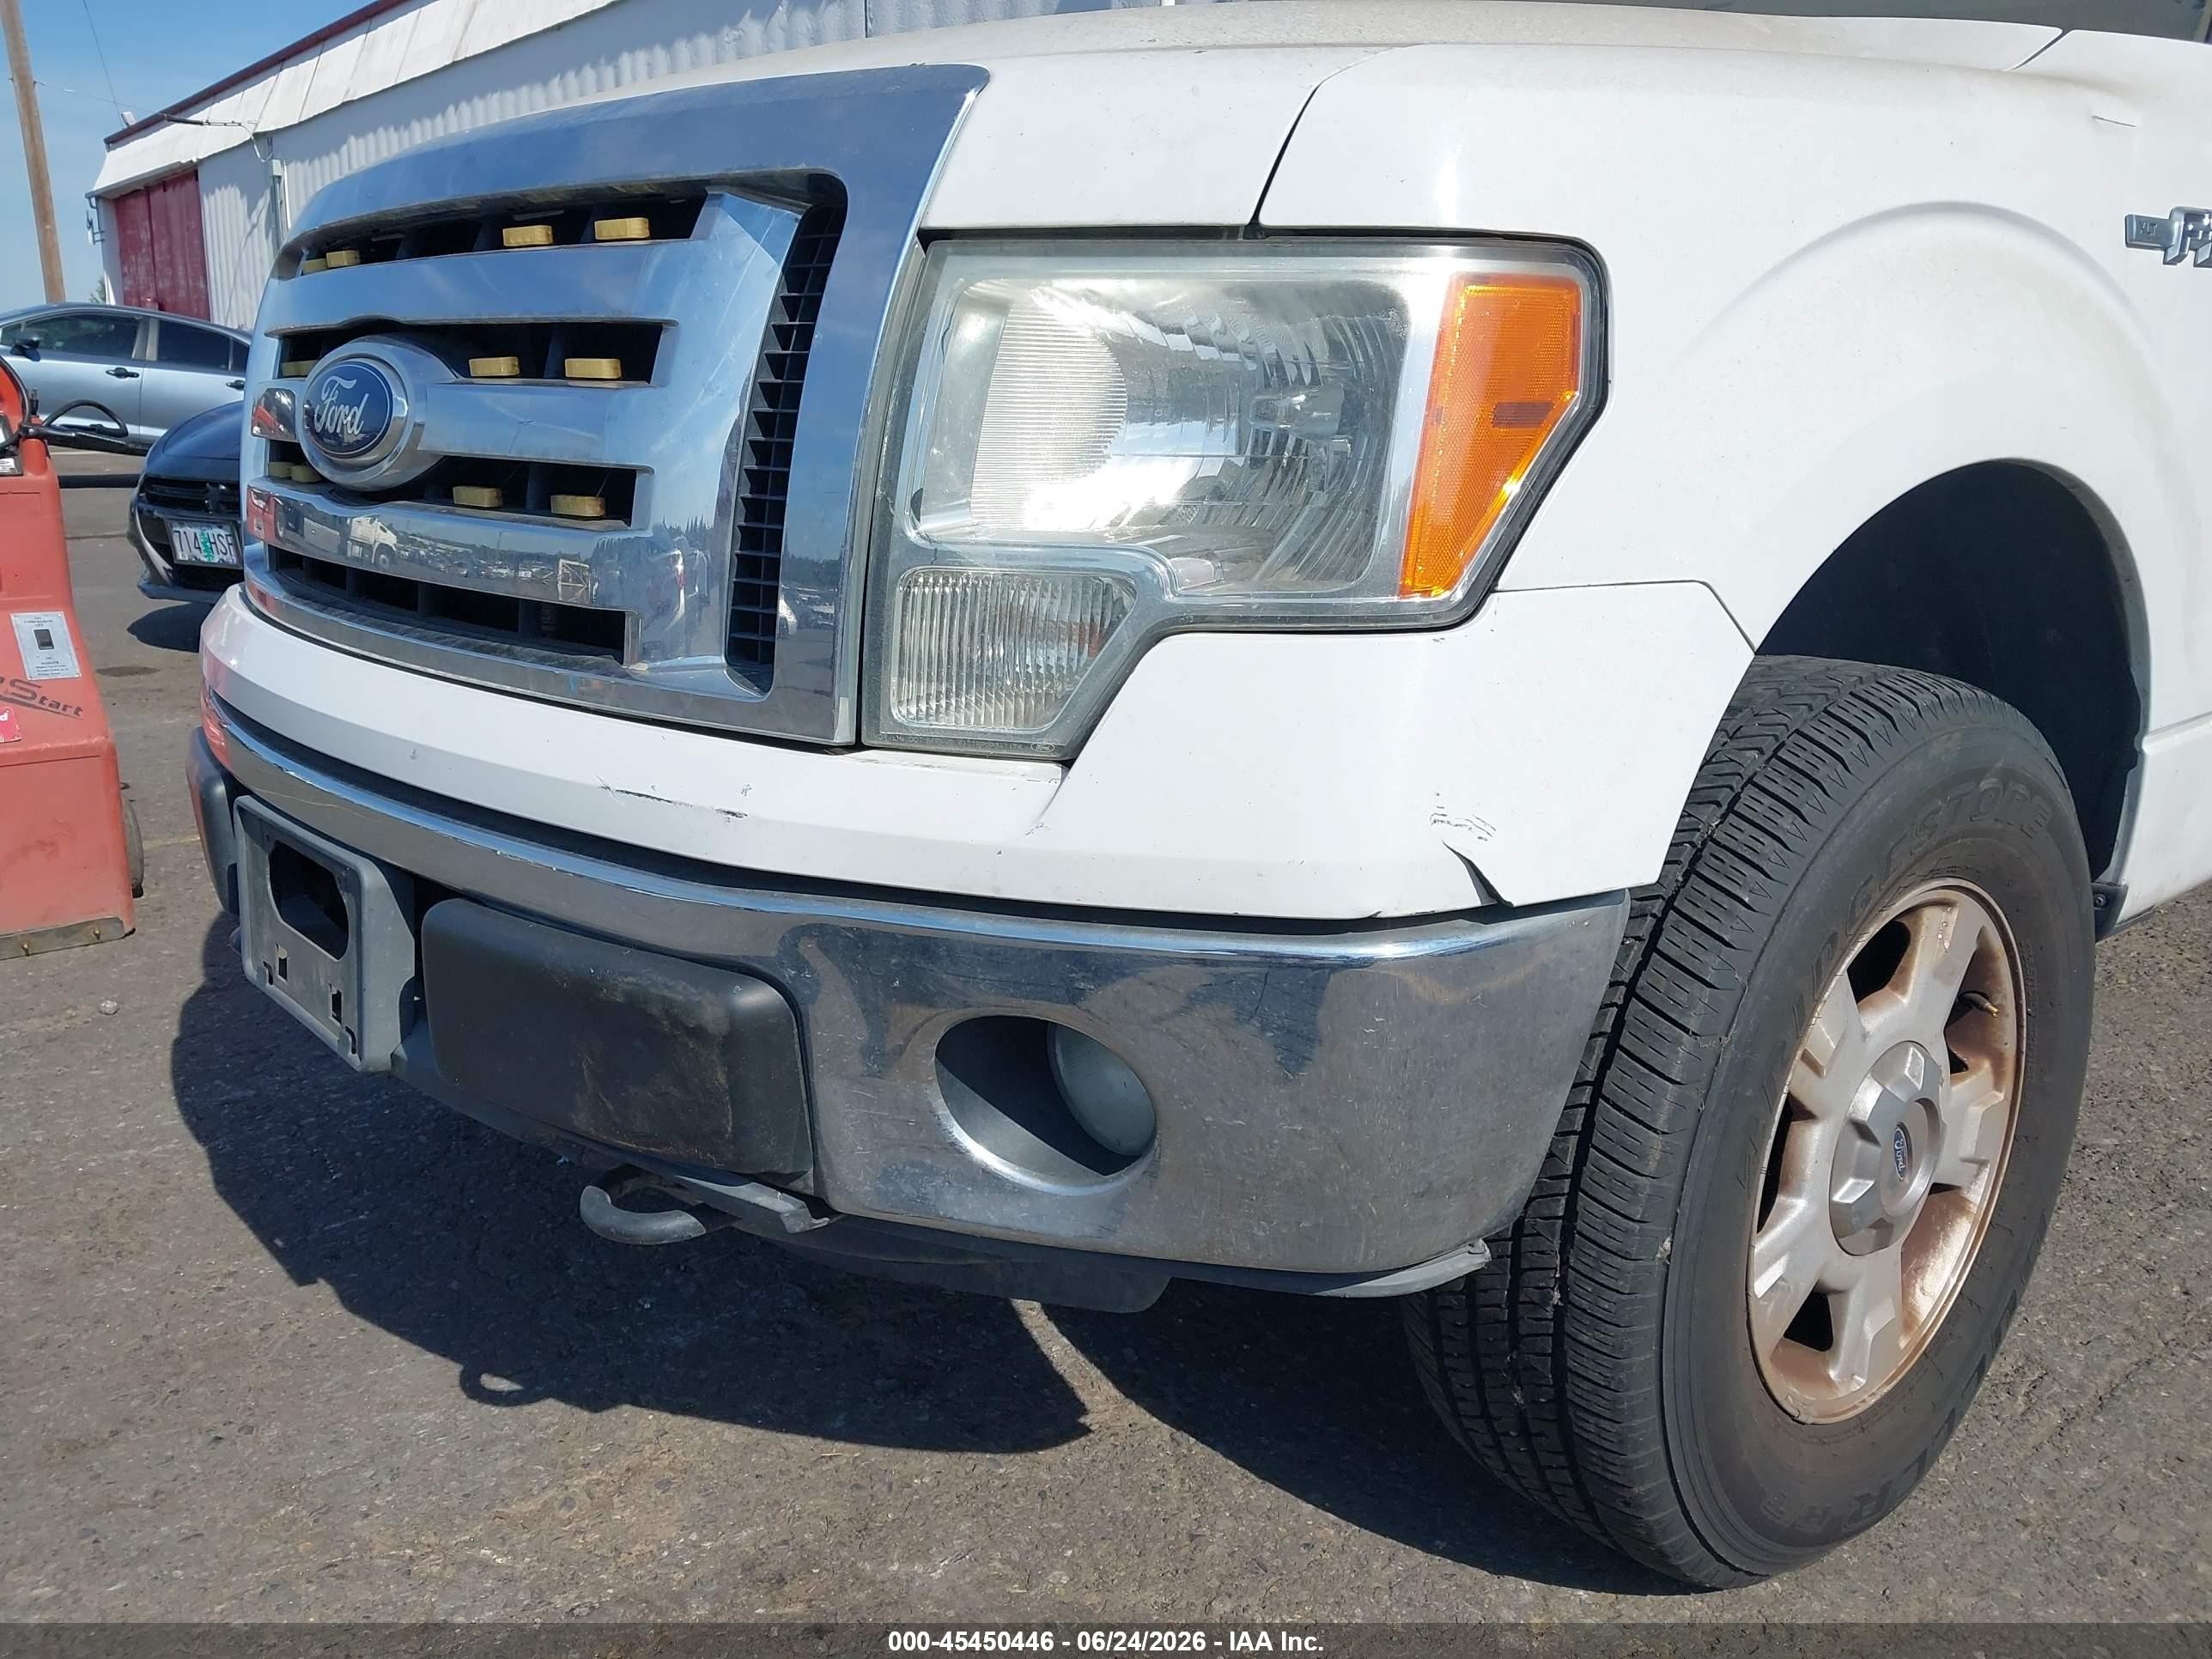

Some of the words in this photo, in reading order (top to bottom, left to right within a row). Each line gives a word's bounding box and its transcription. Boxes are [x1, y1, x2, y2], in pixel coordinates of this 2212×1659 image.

[2138, 220, 2158, 237] XLT
[314, 375, 369, 434] Ford
[173, 530, 203, 554] 714
[1894, 1139, 1906, 1171] Ford
